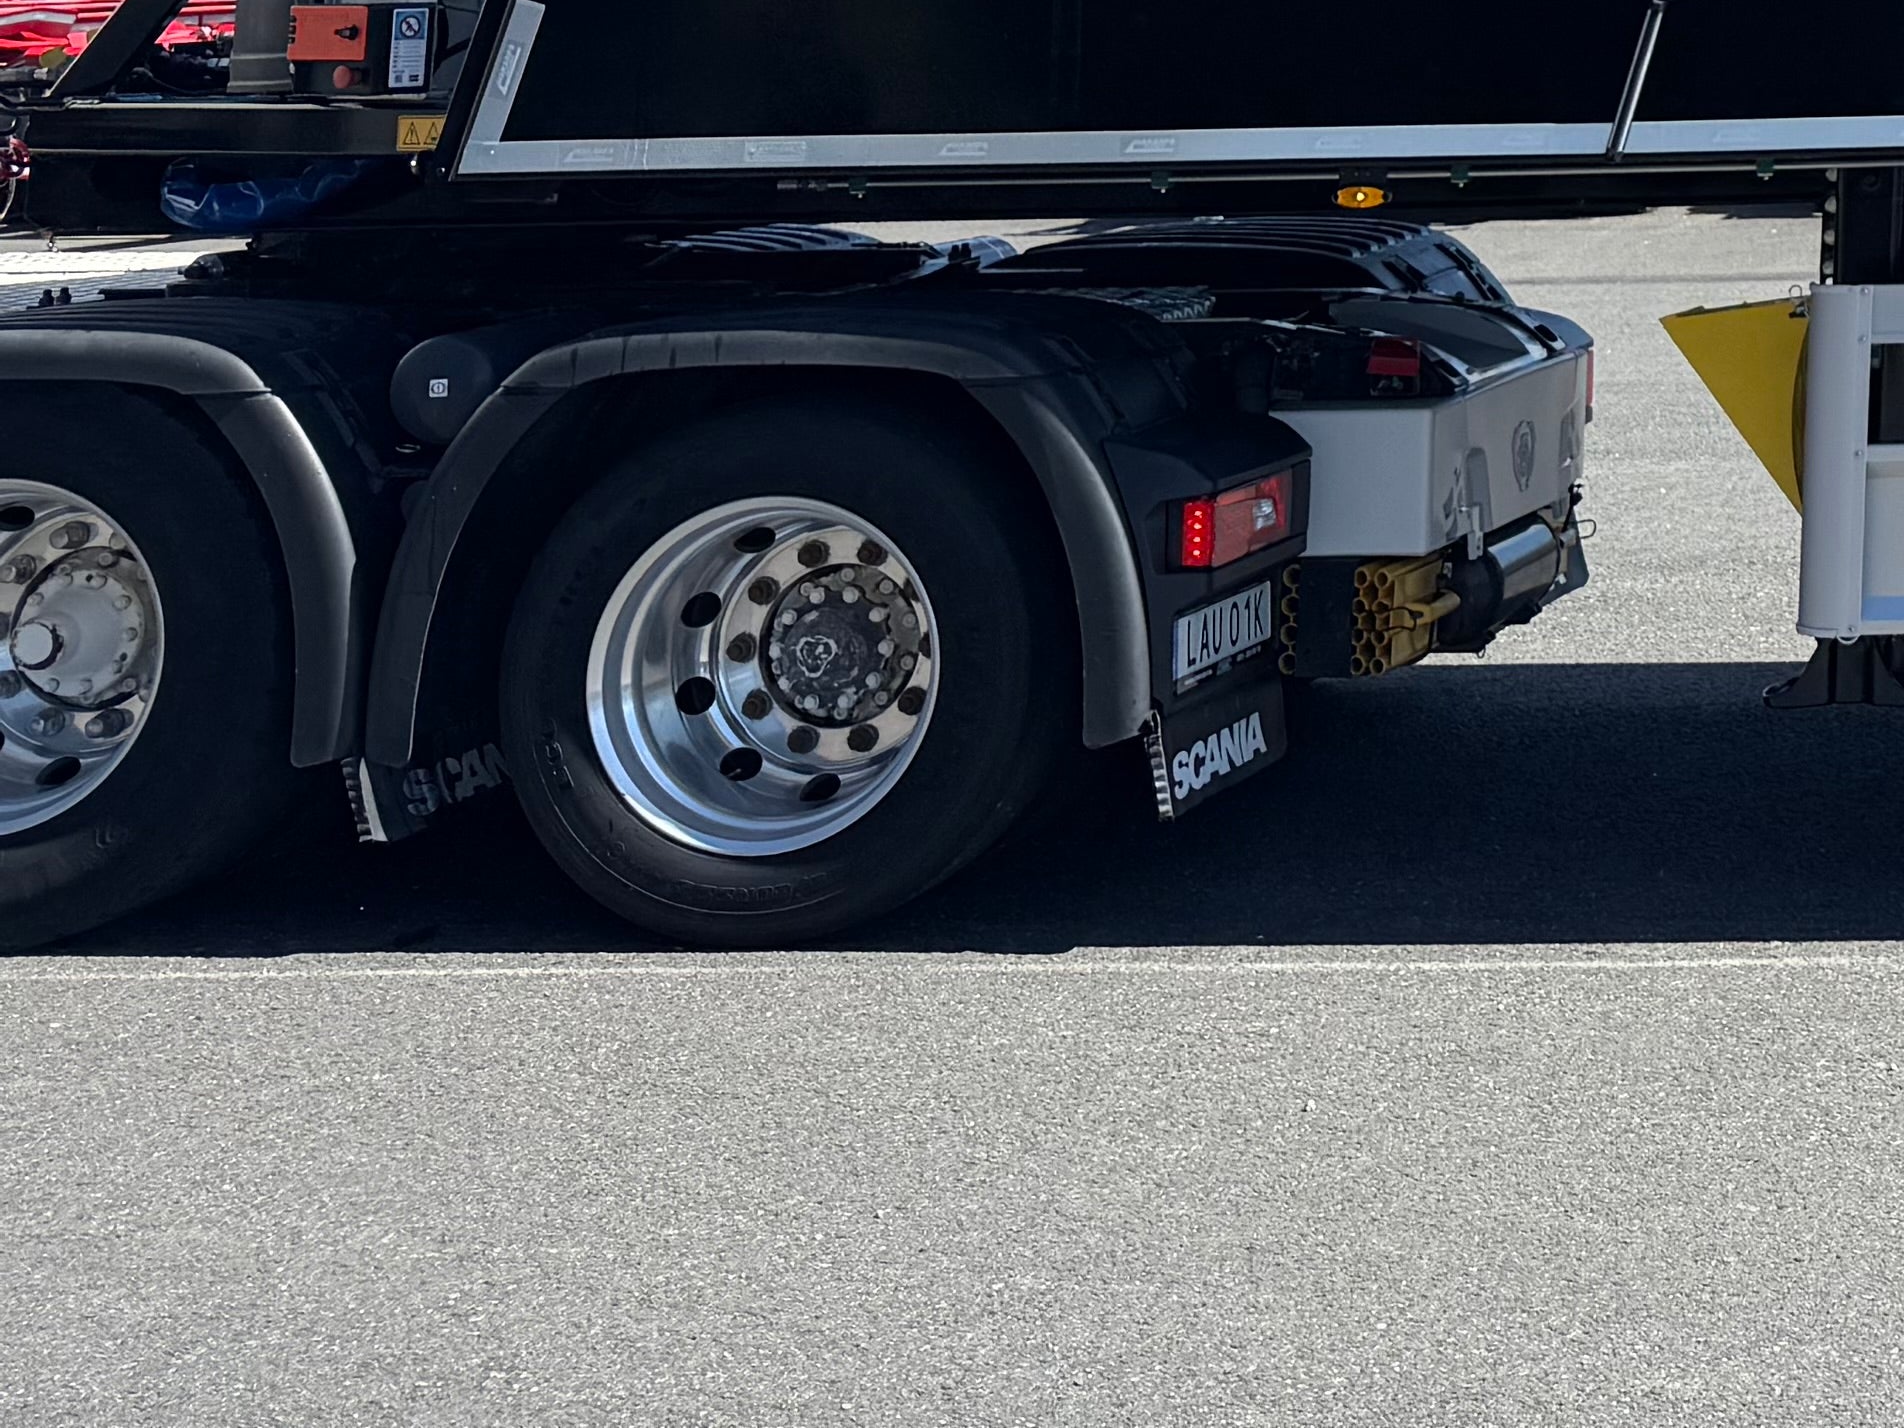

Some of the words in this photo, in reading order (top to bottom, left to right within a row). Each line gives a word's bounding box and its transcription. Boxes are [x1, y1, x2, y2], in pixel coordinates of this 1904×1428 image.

[1186, 606, 1223, 668] LAU
[403, 743, 512, 817] SCAN
[1172, 711, 1268, 800] SCANIA
